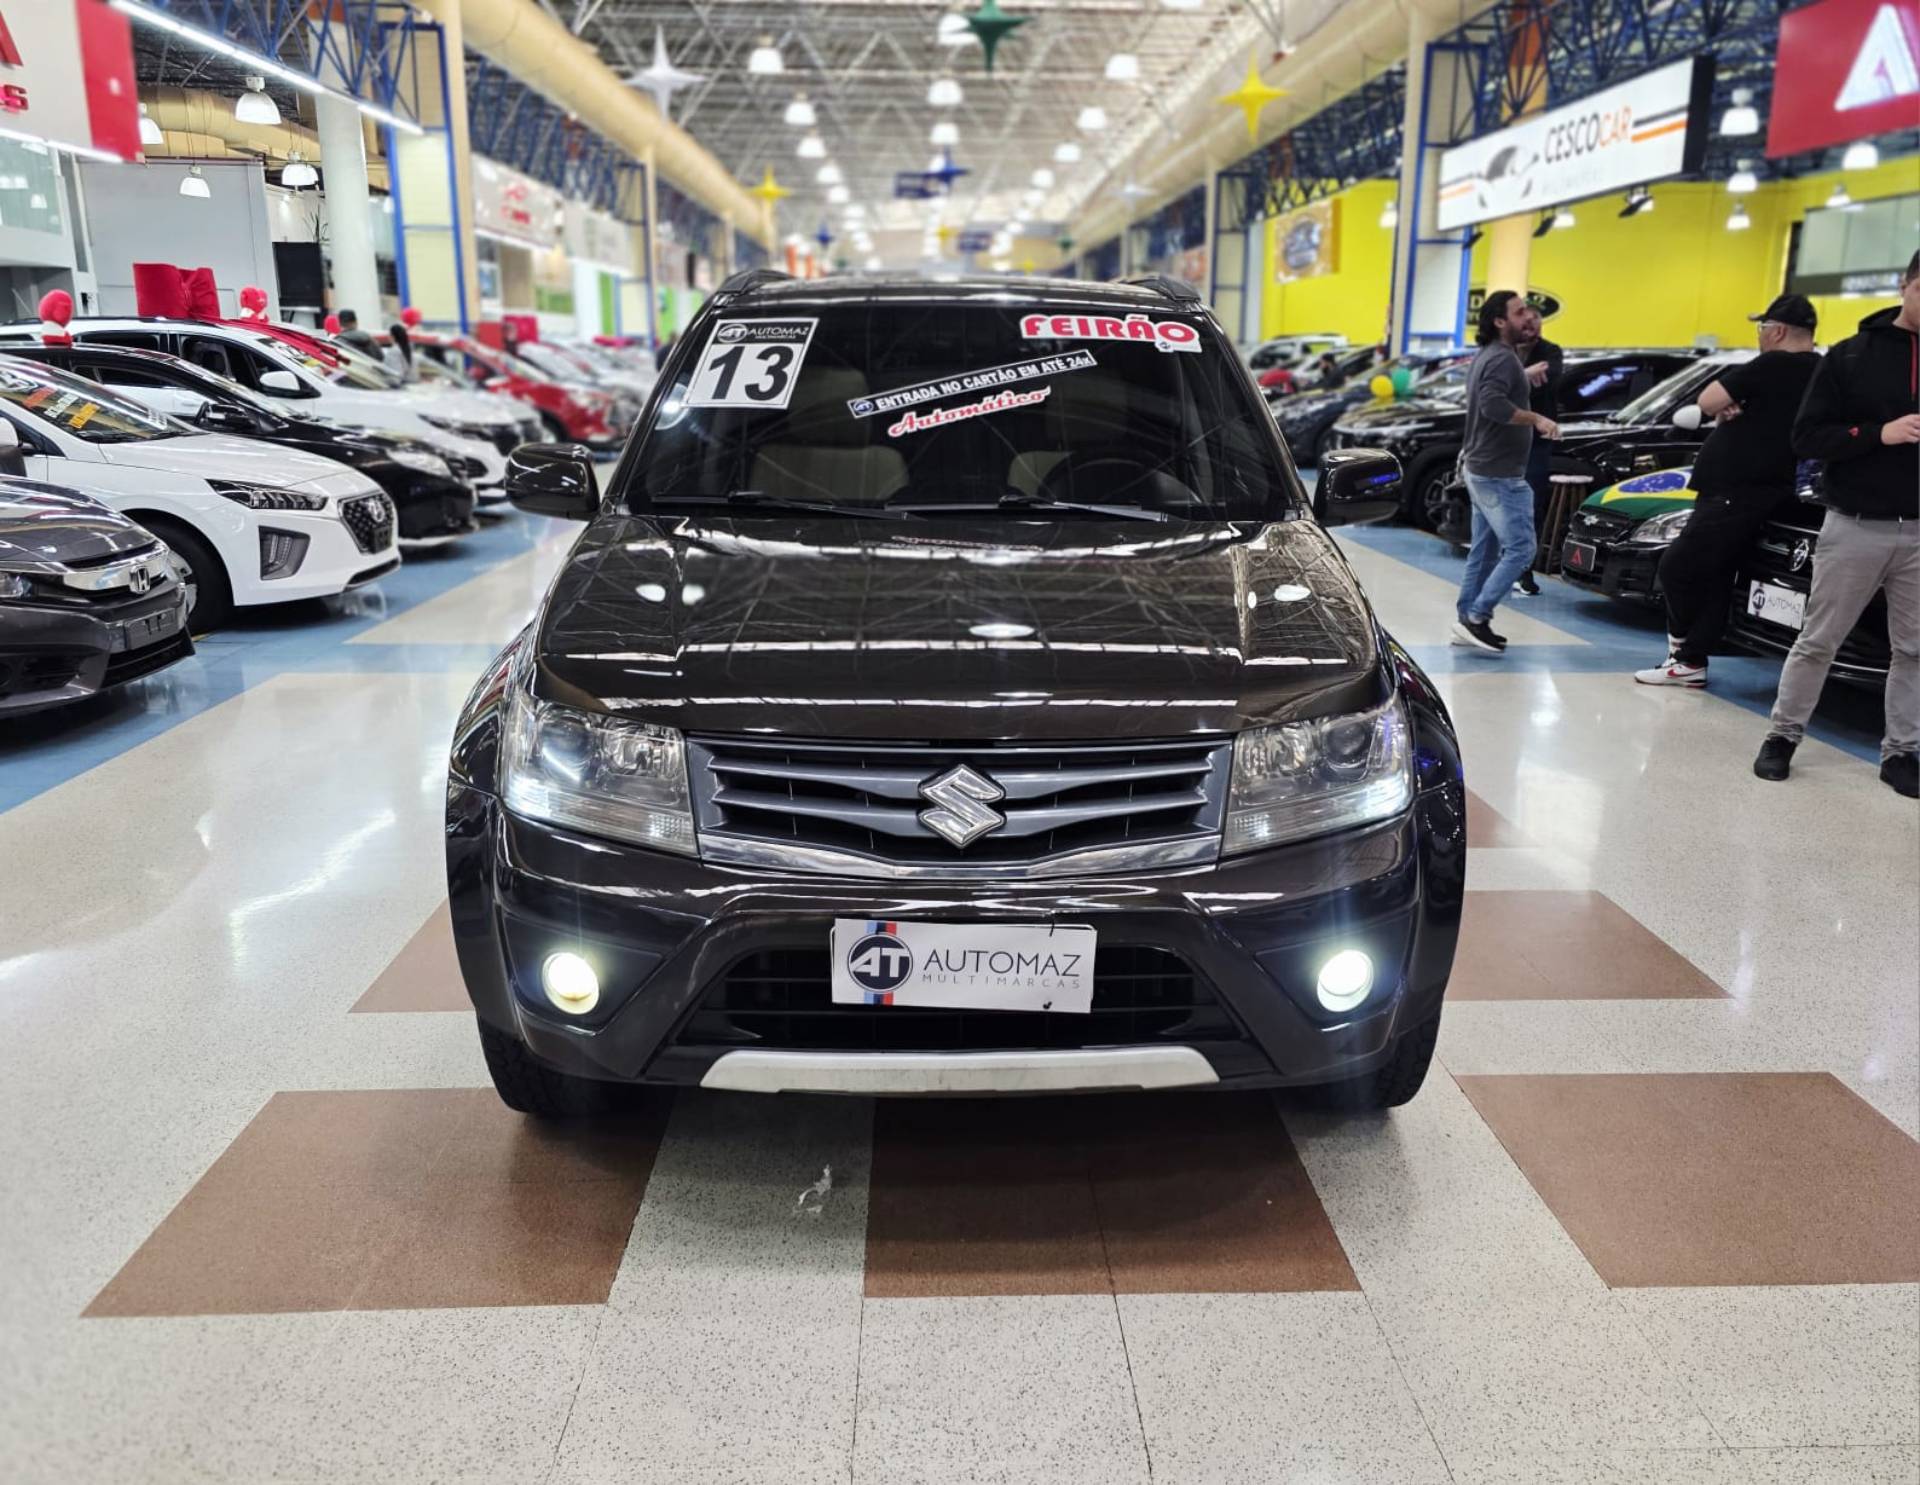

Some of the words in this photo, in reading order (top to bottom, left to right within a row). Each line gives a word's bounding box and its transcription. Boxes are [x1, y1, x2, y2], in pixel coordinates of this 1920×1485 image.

[747, 326, 809, 336] AUTOMAZ
[1024, 315, 1196, 343] FEIRÃO
[708, 345, 794, 401] 13
[876, 386, 940, 410] ENTRADA
[940, 380, 961, 395] NO
[963, 369, 1018, 389] CARTÃO
[1019, 364, 1041, 379] EM
[1042, 356, 1067, 373] ATÉ
[888, 387, 1050, 436] Automático
[923, 948, 1081, 977] AUTOMAZ
[922, 973, 1081, 989] MULTIMARCAS
